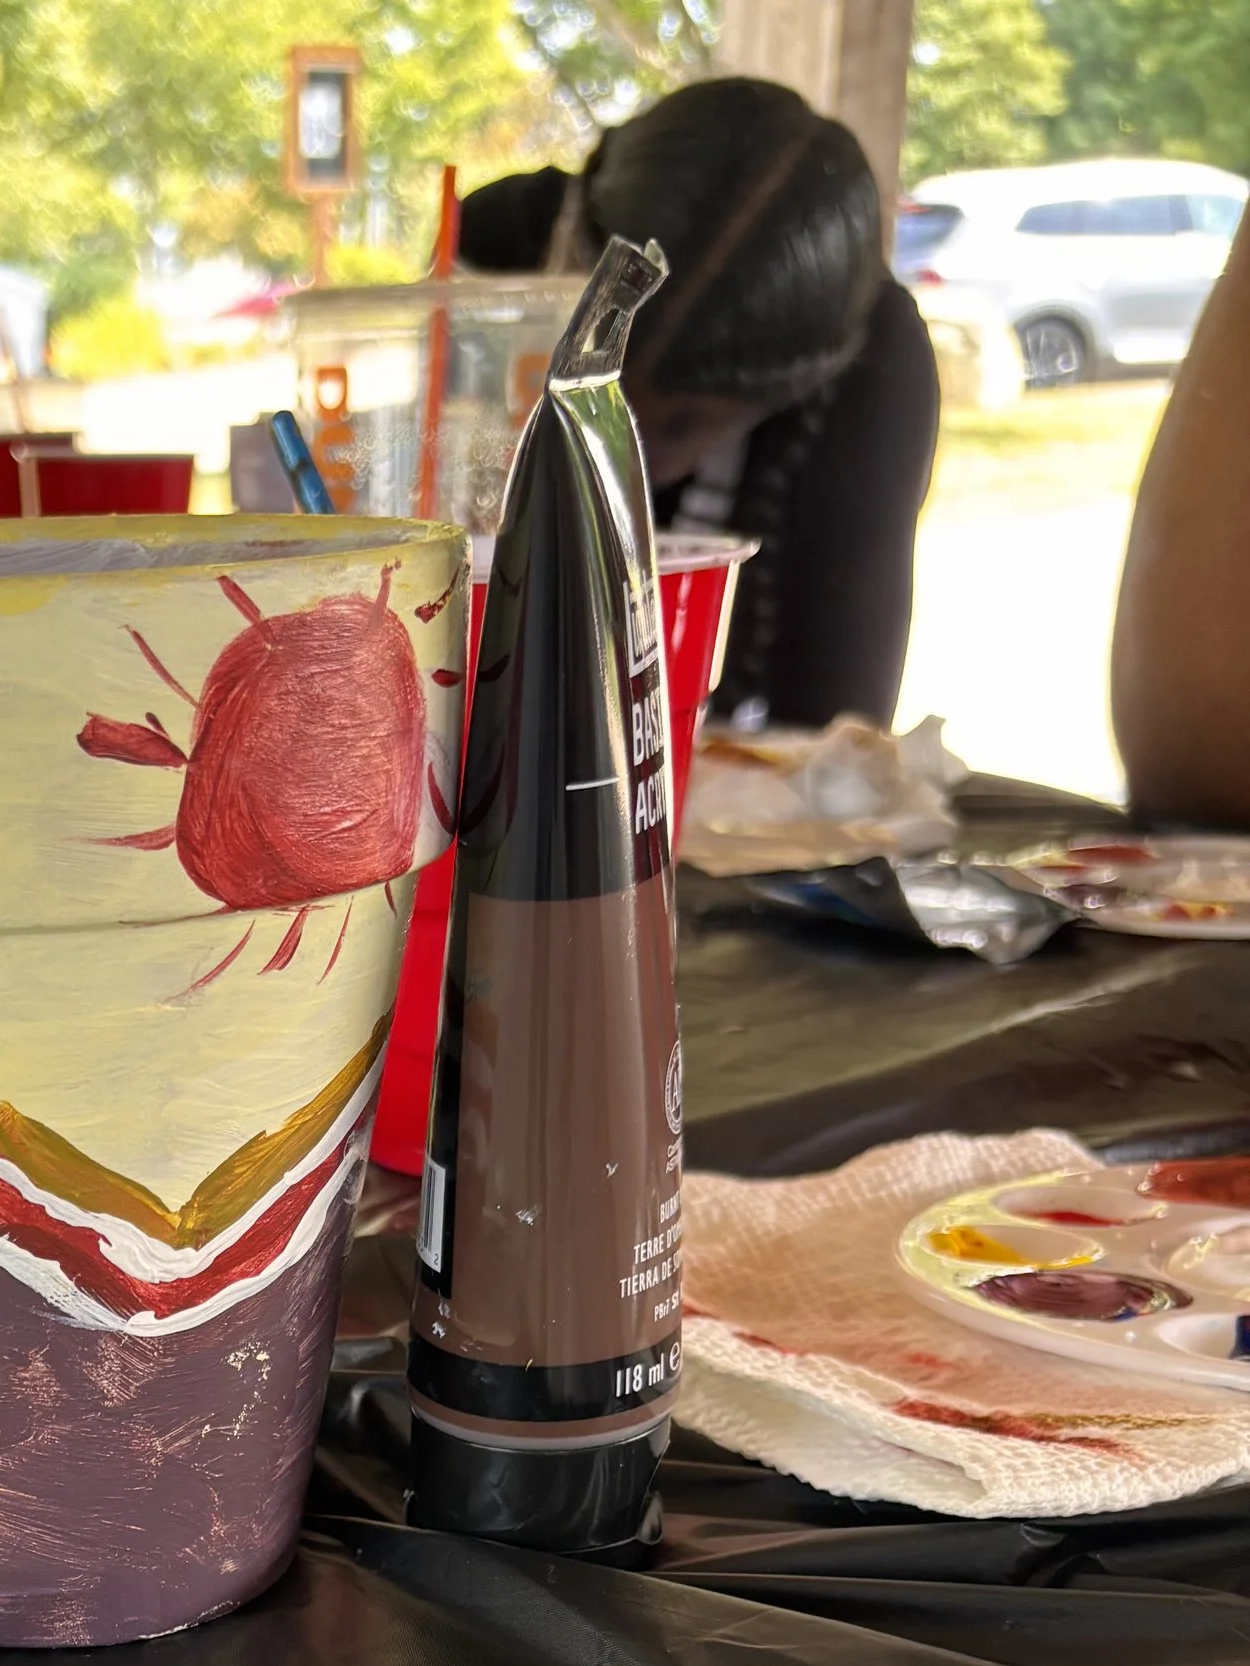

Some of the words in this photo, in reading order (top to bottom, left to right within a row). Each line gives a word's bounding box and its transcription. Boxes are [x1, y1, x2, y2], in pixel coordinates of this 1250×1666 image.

[633, 1233, 665, 1265] TERRE
[619, 1265, 659, 1299] TIERRA
[661, 1257, 672, 1281] DE
[616, 1363, 643, 1397] 118
[648, 1352, 665, 1387] ml
